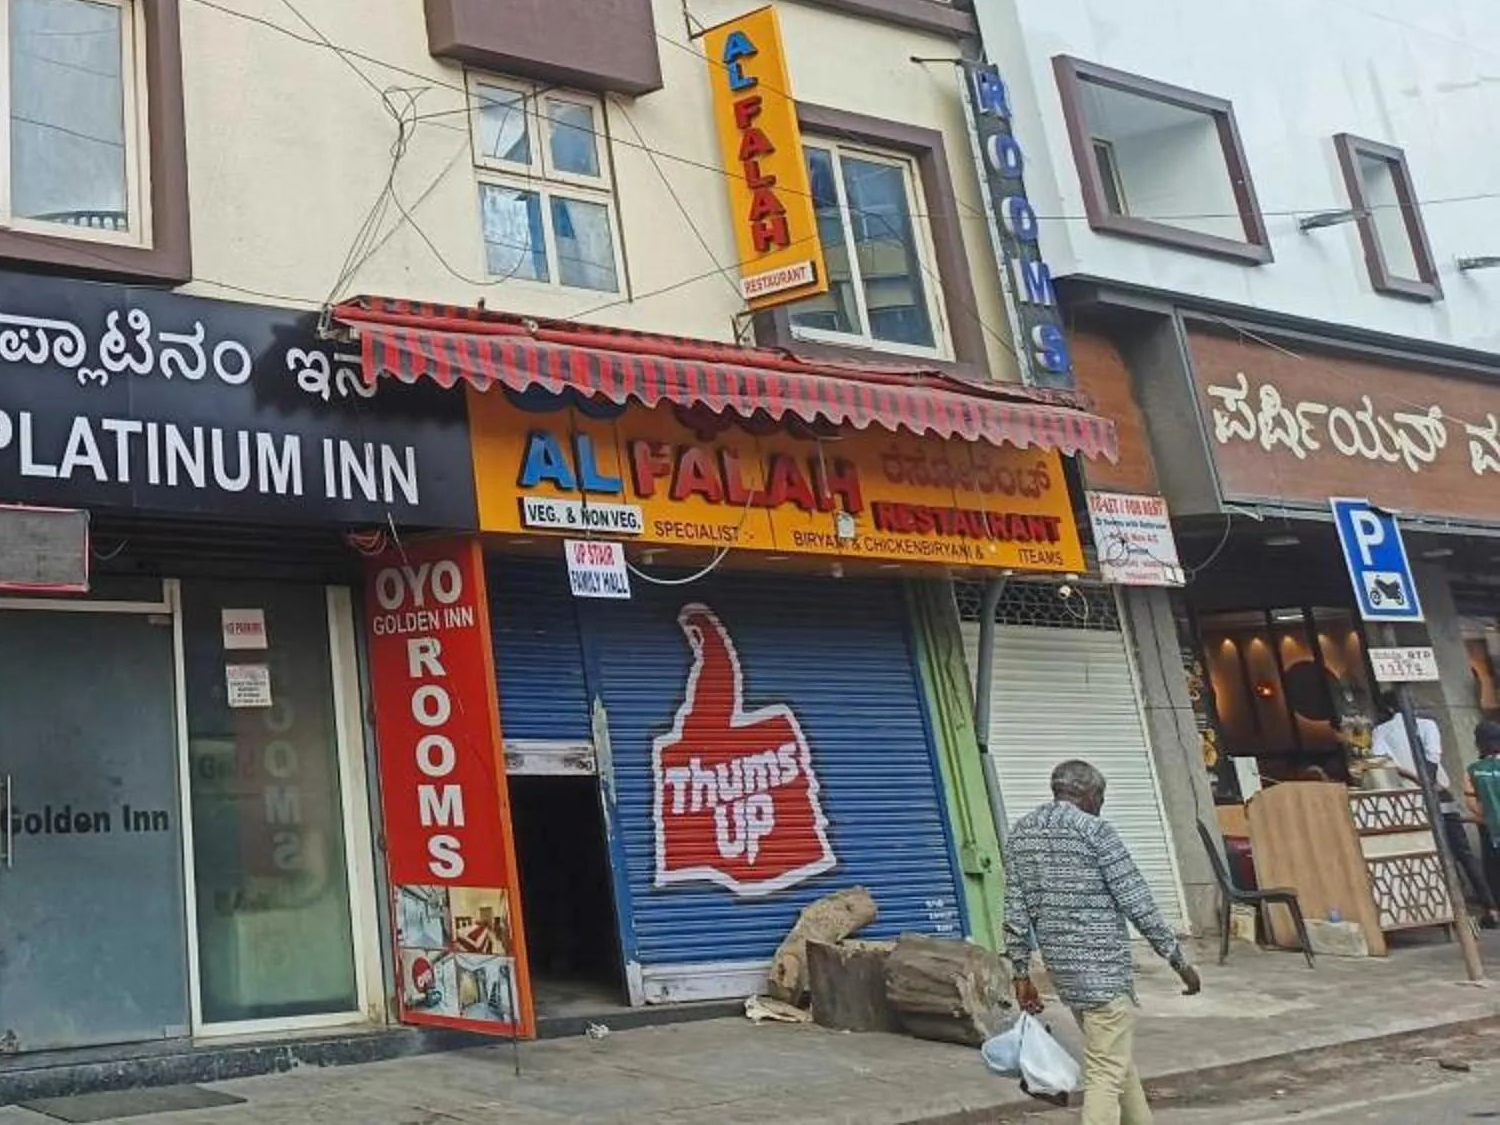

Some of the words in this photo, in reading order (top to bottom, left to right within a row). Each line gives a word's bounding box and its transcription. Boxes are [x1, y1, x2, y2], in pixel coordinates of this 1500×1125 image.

[721, 30, 758, 92] AL
[732, 95, 791, 253] FALAH
[974, 72, 1072, 375] ROOMS
[323, 438, 420, 506] INN
[517, 430, 623, 494] AL
[627, 439, 865, 515] FALAH
[528, 503, 560, 524] VEG.
[566, 507, 577, 525] &
[654, 520, 739, 543] SPECIALIST
[871, 500, 1062, 545] RESTAURANT
[1351, 509, 1385, 567] P
[375, 559, 464, 611] OYO
[373, 611, 441, 636] GOLDEN
[443, 606, 475, 628] INN
[407, 636, 466, 879] ROOMS
[665, 742, 799, 816] Thums
[0, 804, 112, 836] Golden
[123, 804, 170, 833] Inn
